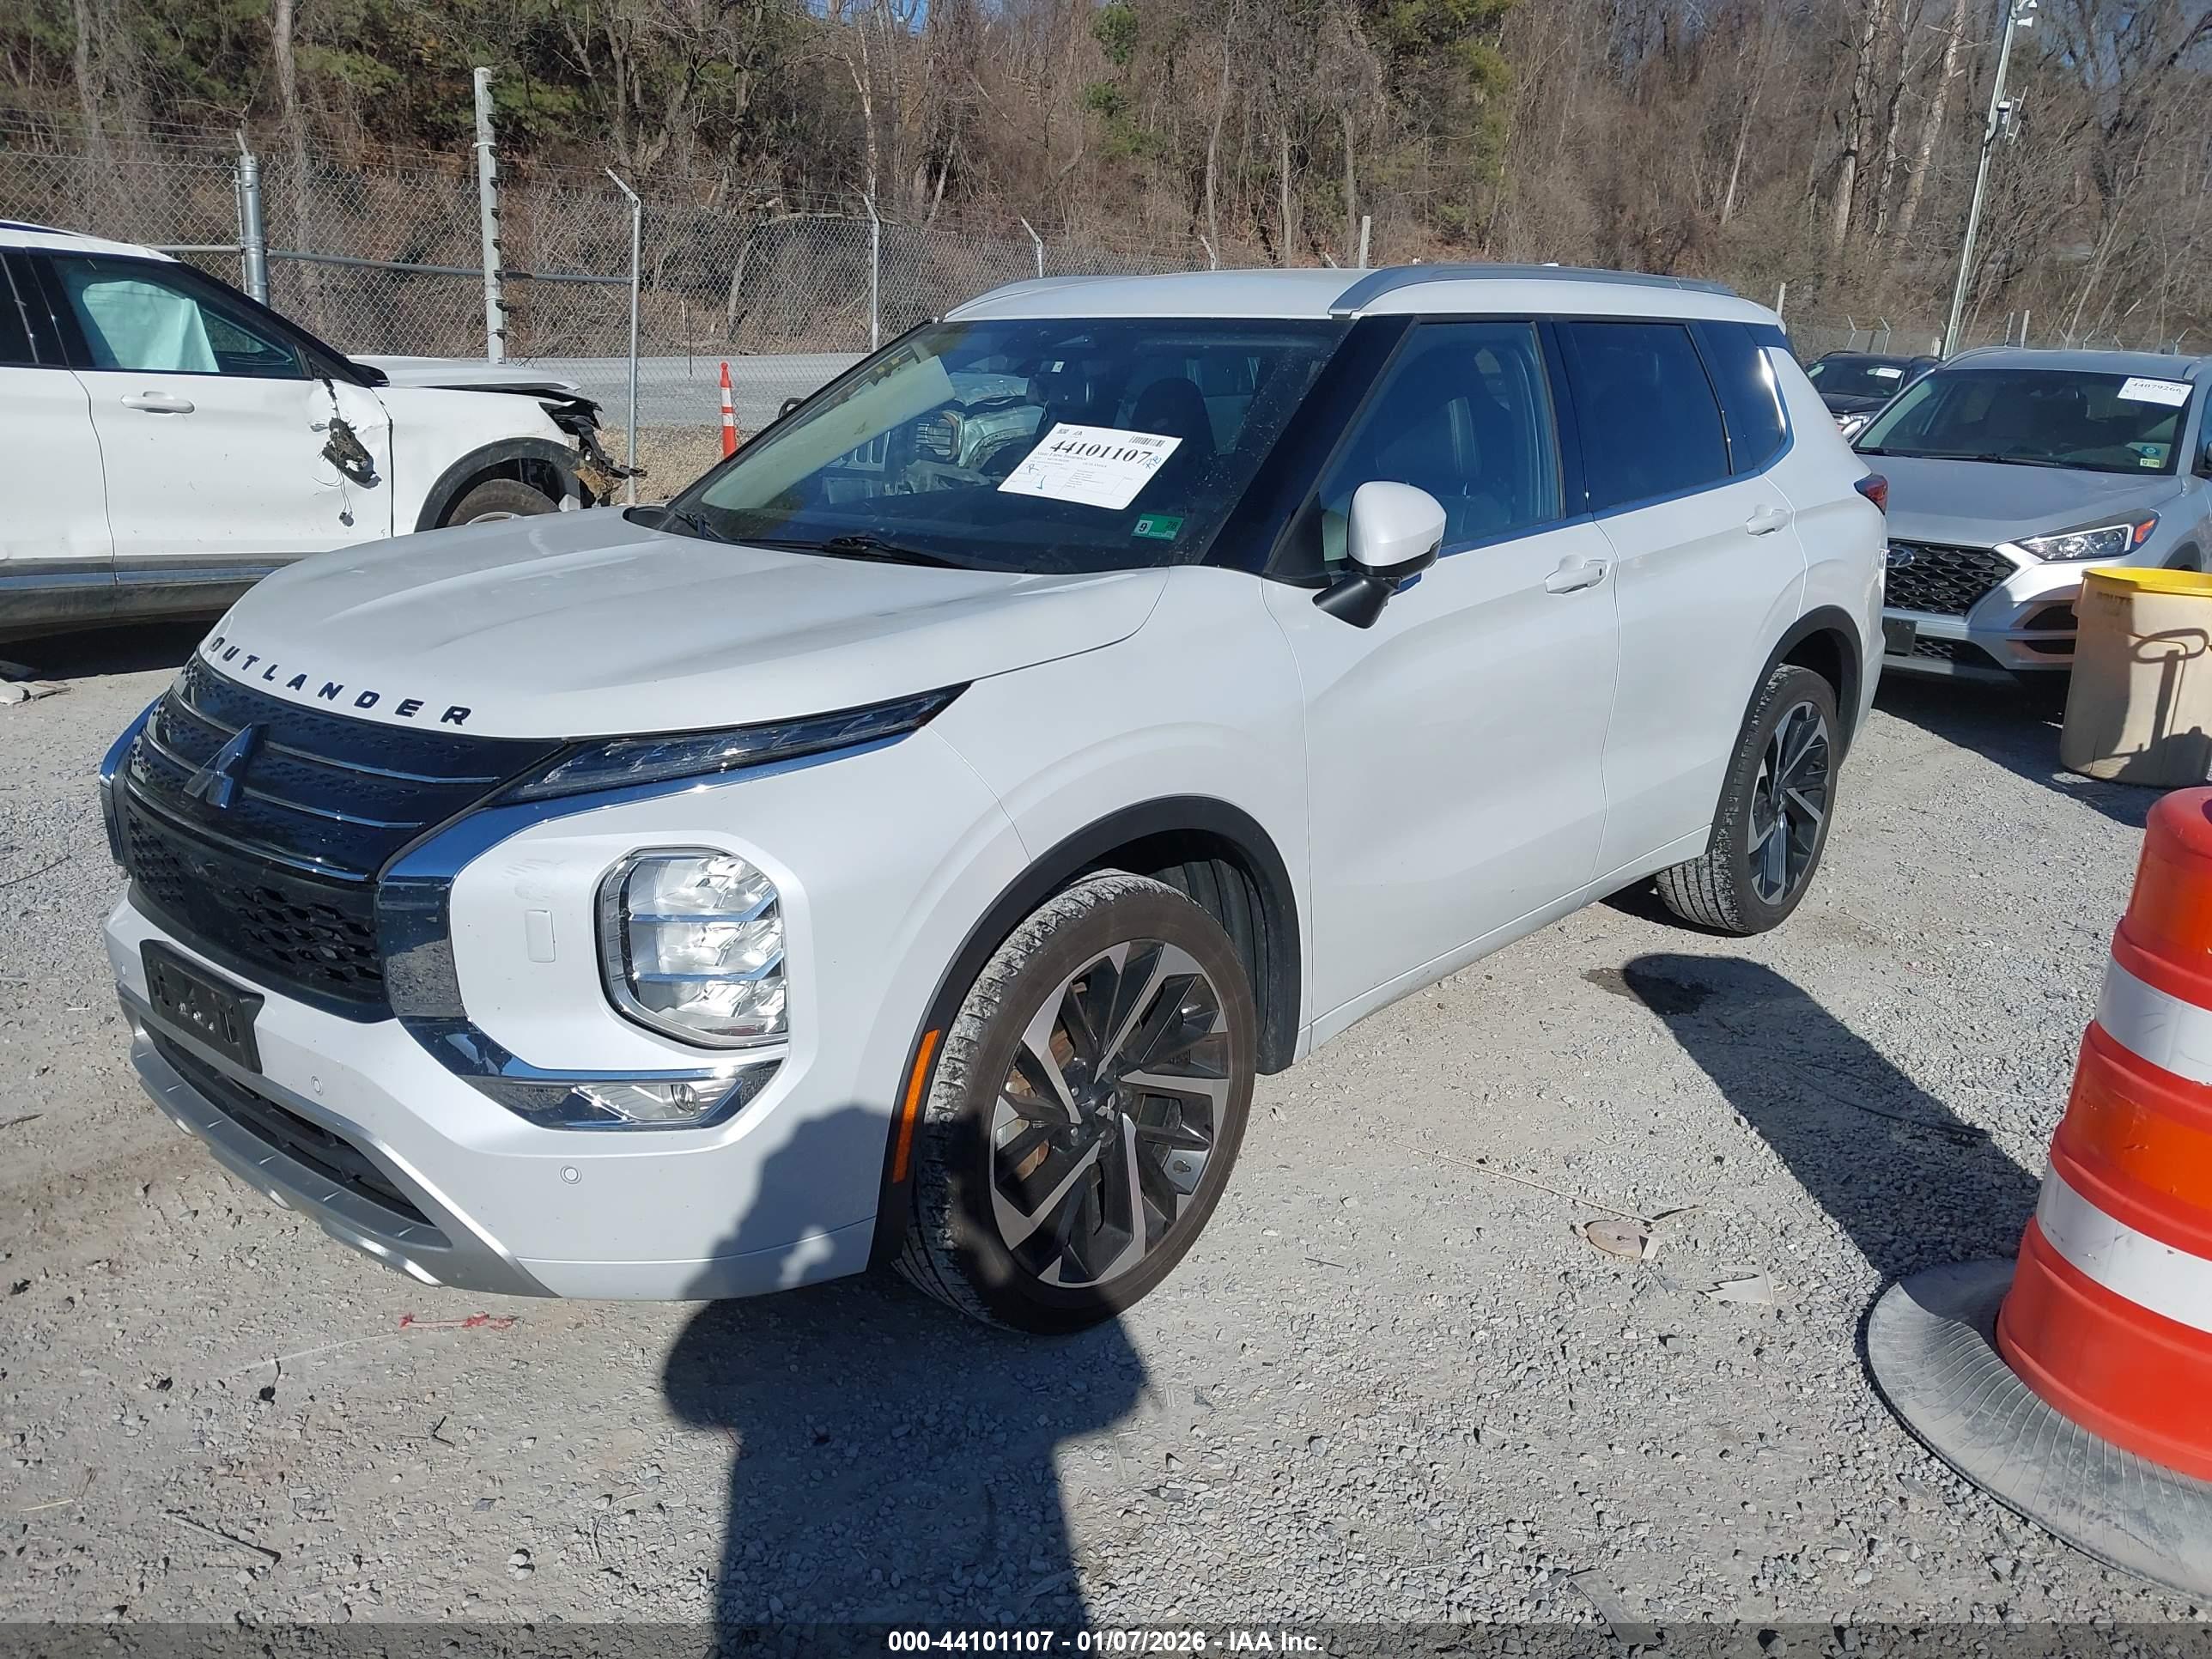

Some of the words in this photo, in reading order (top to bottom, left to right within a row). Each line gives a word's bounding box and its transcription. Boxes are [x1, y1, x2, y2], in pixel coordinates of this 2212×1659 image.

[1050, 440, 1154, 465] 44101107
[1139, 522, 1148, 532] 9
[209, 636, 471, 726] OUTLANDER
